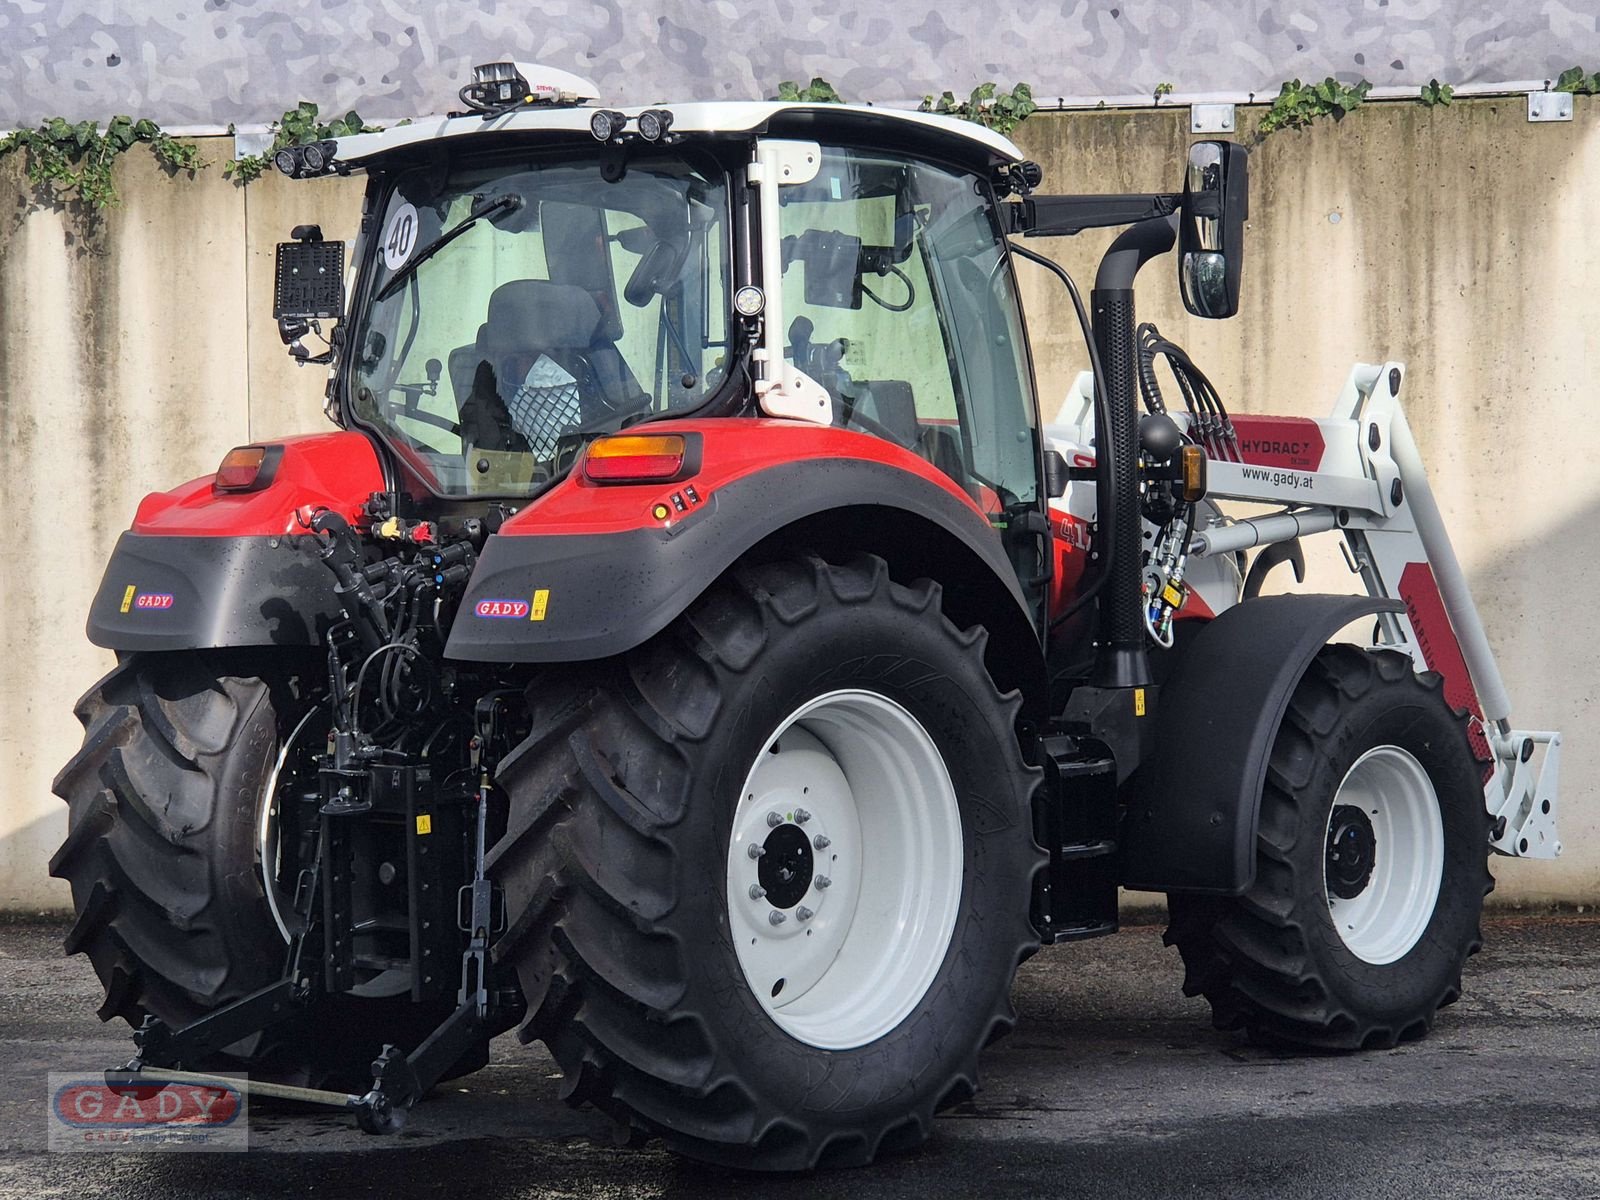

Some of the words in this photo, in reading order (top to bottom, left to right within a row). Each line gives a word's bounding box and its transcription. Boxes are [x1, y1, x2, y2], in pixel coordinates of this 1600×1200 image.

[388, 214, 413, 259] 40
[1242, 440, 1299, 454] HYDRAC
[1242, 467, 1314, 489] www.gady.at
[138, 595, 170, 607] GADY
[480, 603, 524, 615] GADY
